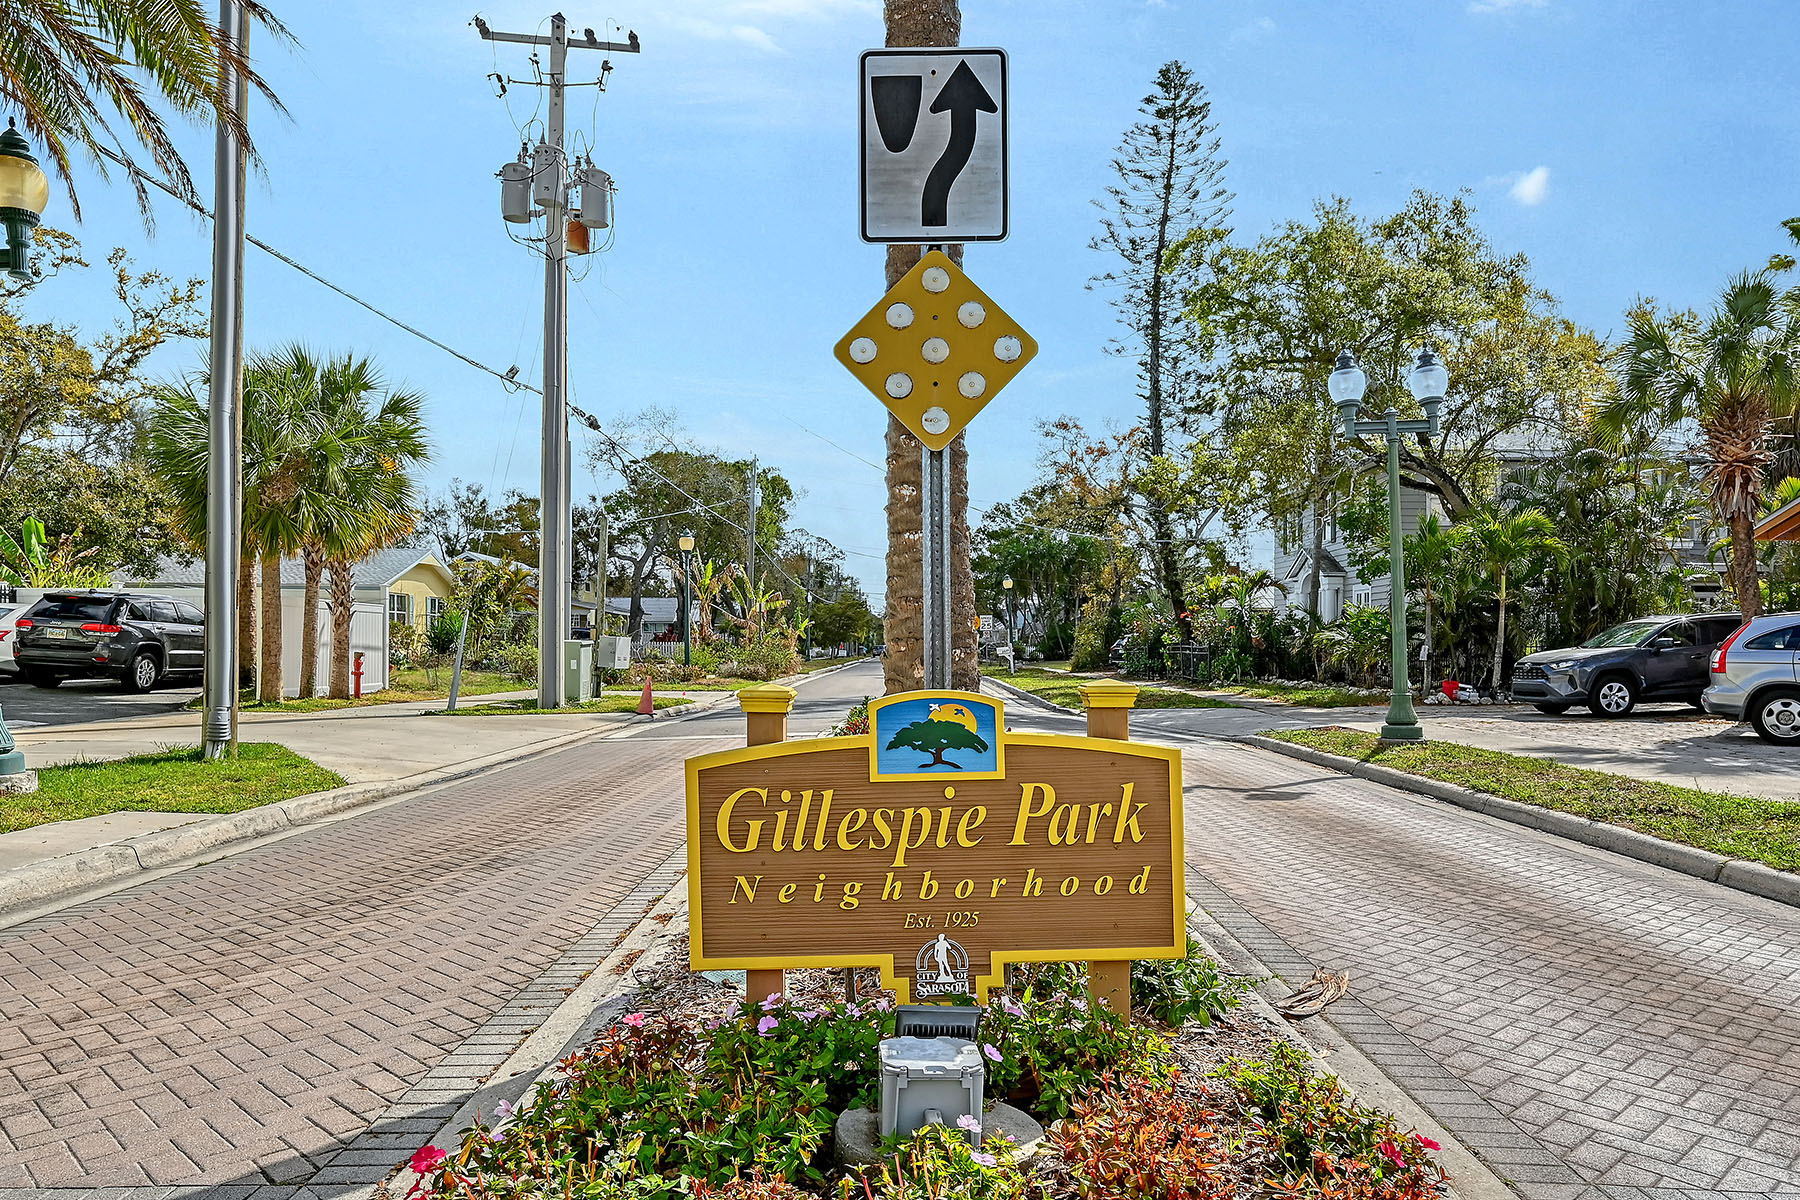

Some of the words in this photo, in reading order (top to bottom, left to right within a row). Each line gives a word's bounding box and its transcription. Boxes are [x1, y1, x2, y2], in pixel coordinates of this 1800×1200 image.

[716, 786, 987, 868] Gillespie
[1007, 781, 1149, 848] Park
[729, 866, 1152, 910] Neighborhood
[904, 913, 935, 929] Est.
[944, 911, 980, 928] 1925
[956, 972, 968, 980] OF
[916, 982, 969, 998] SARASOTA
